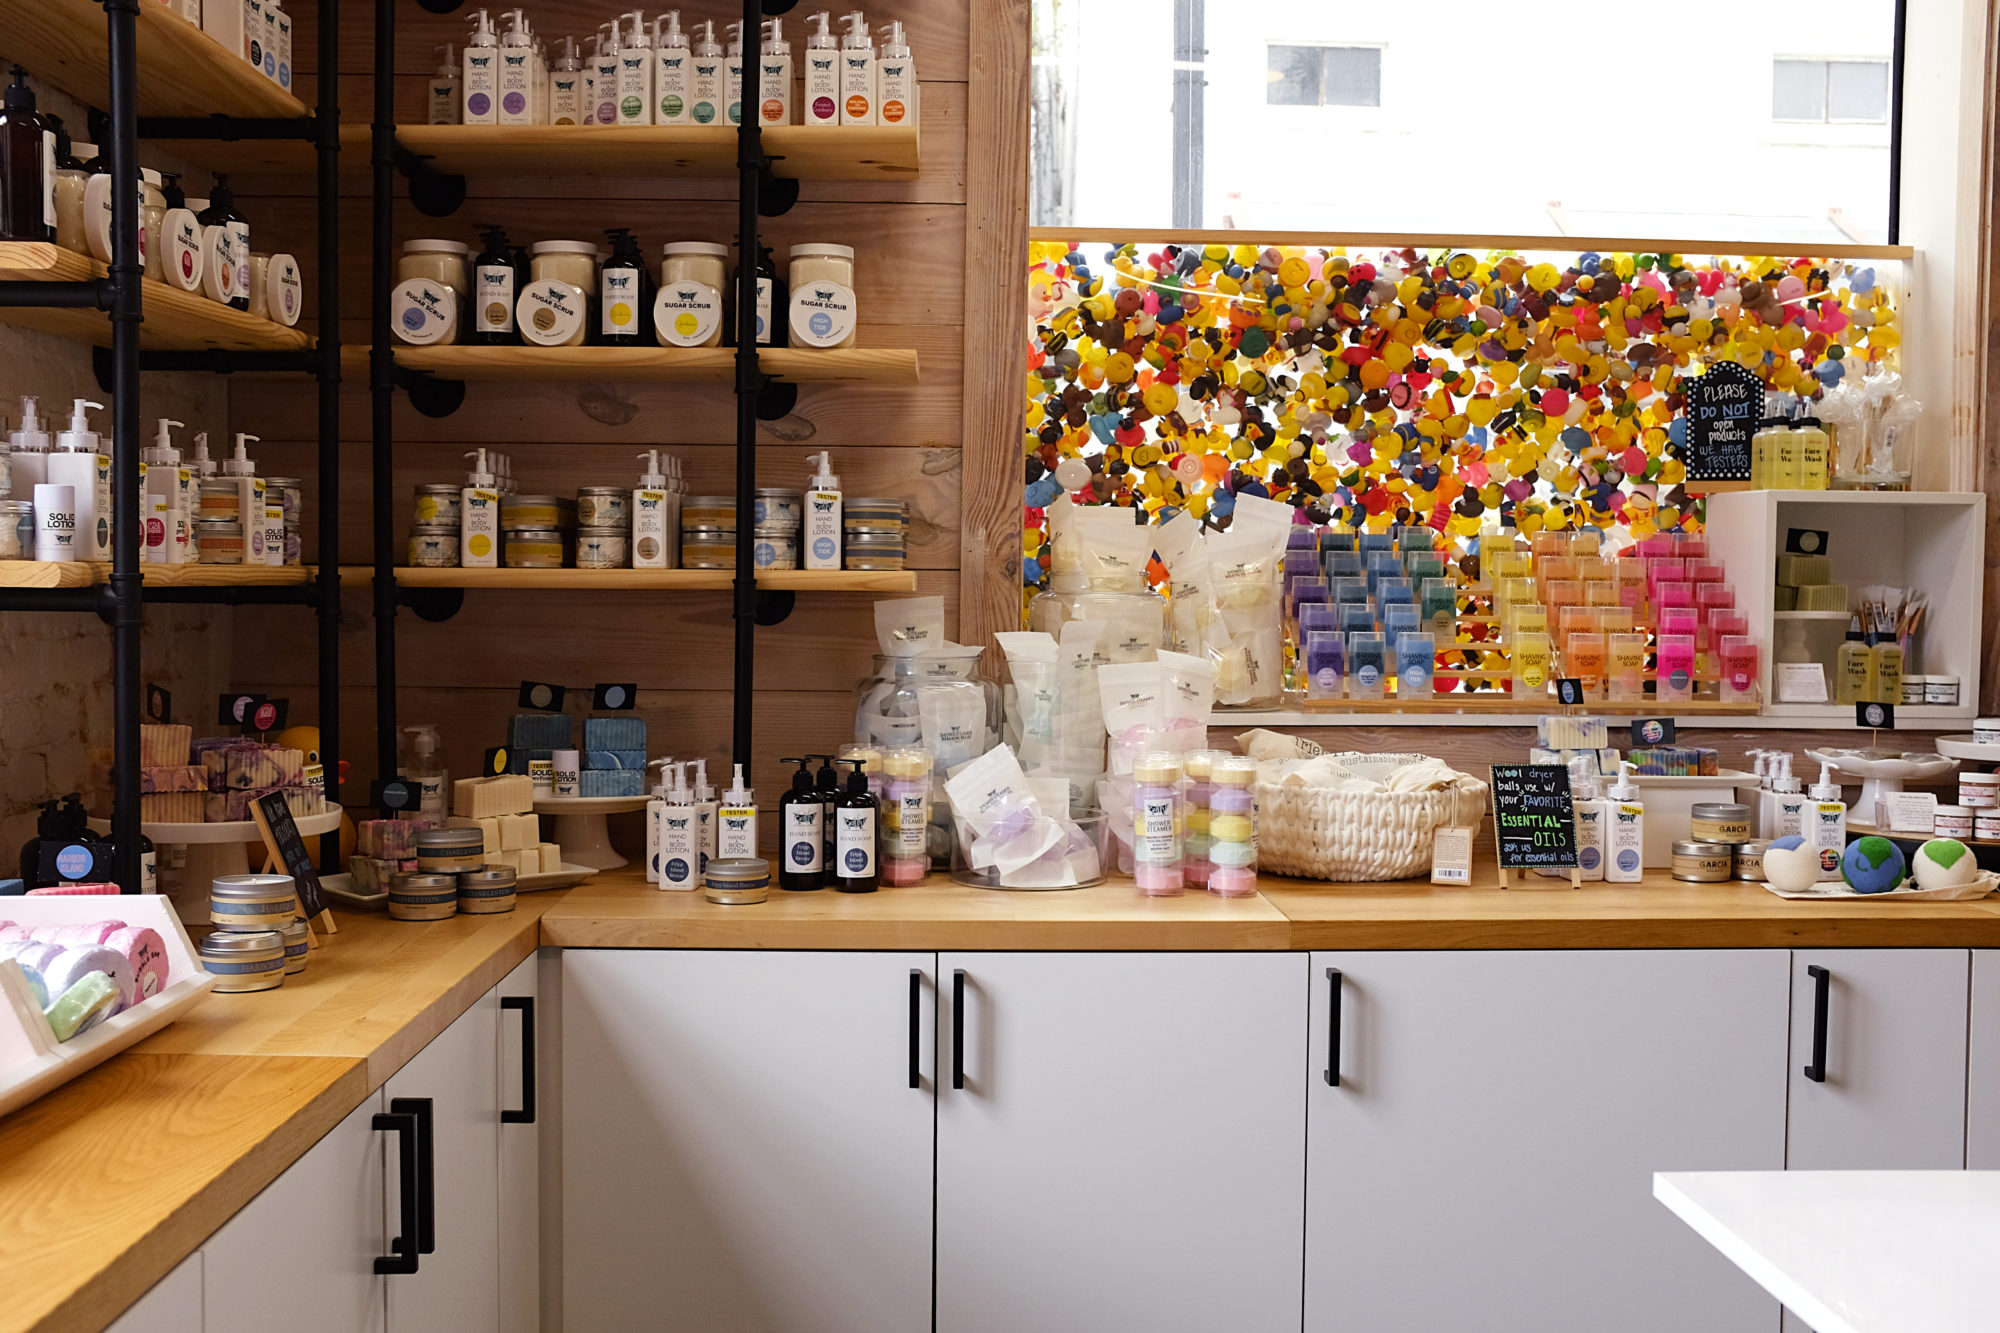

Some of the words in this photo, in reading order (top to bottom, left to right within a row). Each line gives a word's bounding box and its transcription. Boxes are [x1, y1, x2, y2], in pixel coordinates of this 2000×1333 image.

[405, 290, 426, 308] SUGAR
[426, 304, 445, 321] SCRUB
[531, 292, 553, 307] SUGAR
[552, 301, 574, 316] SCRUB
[801, 300, 822, 308] SUGAR
[824, 302, 847, 311] SCRUB
[1703, 383, 1748, 403] PLEASE
[1700, 406, 1717, 418] DO
[1723, 402, 1750, 417] NOT
[1713, 419, 1734, 432] open
[1708, 430, 1746, 444] products
[1699, 445, 1716, 456] WE
[1721, 444, 1744, 455] HAVE
[1705, 454, 1748, 468] TESTERS
[476, 491, 497, 501] TESTER
[642, 492, 664, 500] TESTER
[48, 513, 75, 521] SOLID
[1529, 768, 1554, 782] dryer
[1498, 781, 1520, 791] balls
[1544, 782, 1555, 792] w/
[1499, 795, 1519, 808] your
[1523, 794, 1565, 808] FAVORITE
[1621, 806, 1642, 815] TESTER
[1501, 813, 1561, 828] ESSENTIAL
[1534, 832, 1566, 846] OILS
[1510, 853, 1522, 863] for
[1525, 853, 1556, 862] essential
[1561, 851, 1574, 861] oils
[1699, 860, 1727, 868] GARCIA
[393, 895, 440, 904] CHARLESTON
